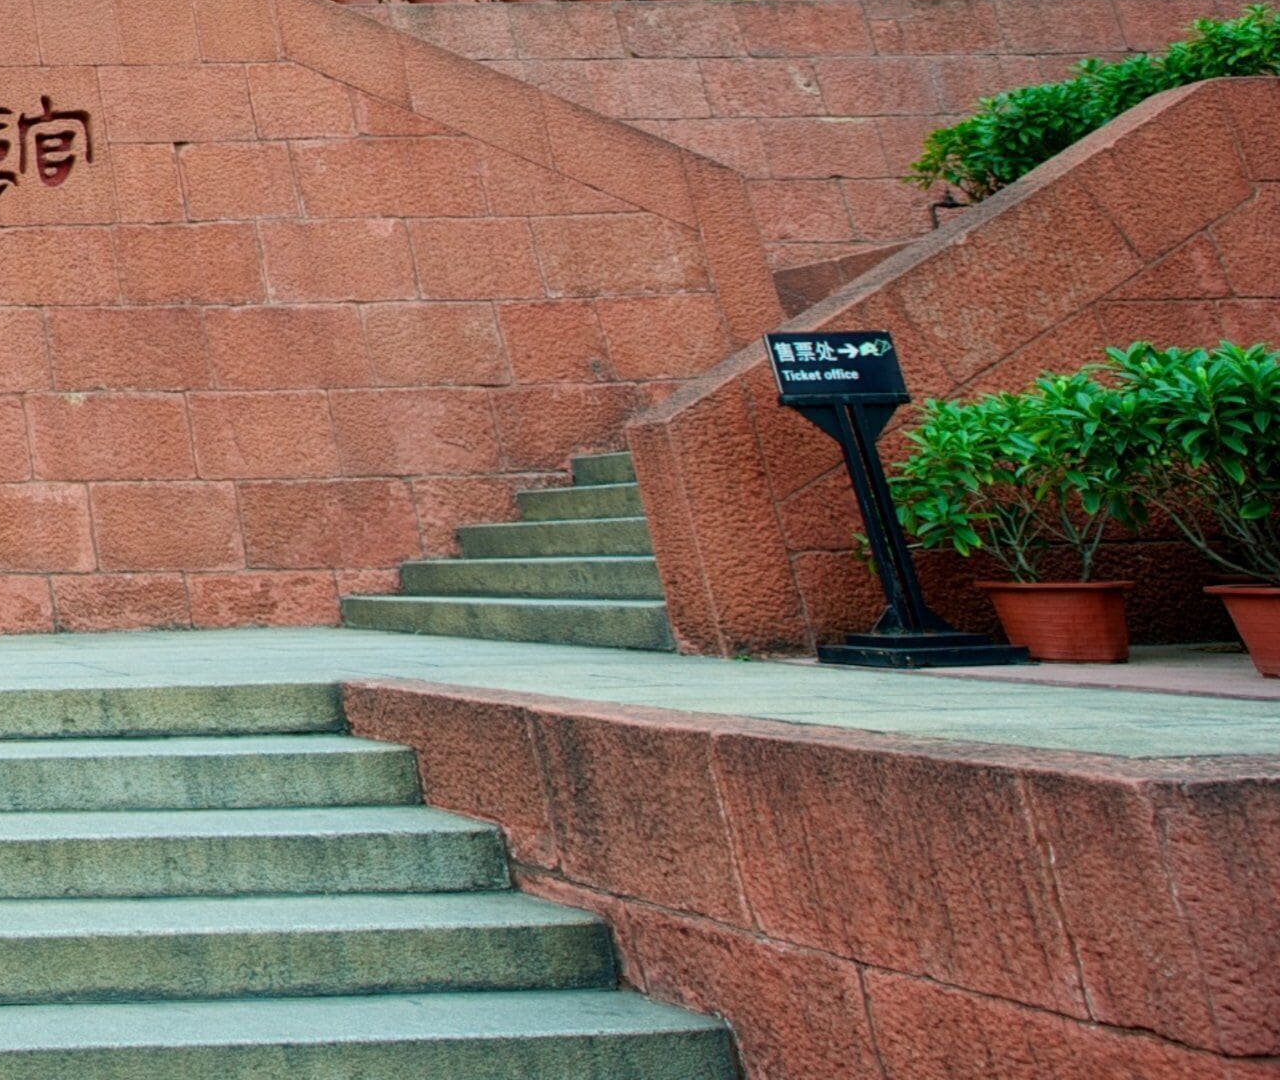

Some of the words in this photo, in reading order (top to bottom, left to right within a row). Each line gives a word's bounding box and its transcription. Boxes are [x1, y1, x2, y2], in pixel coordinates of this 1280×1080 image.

[773, 340, 838, 363] 售票处
[781, 370, 822, 381] Ticket
[824, 368, 859, 380] office
